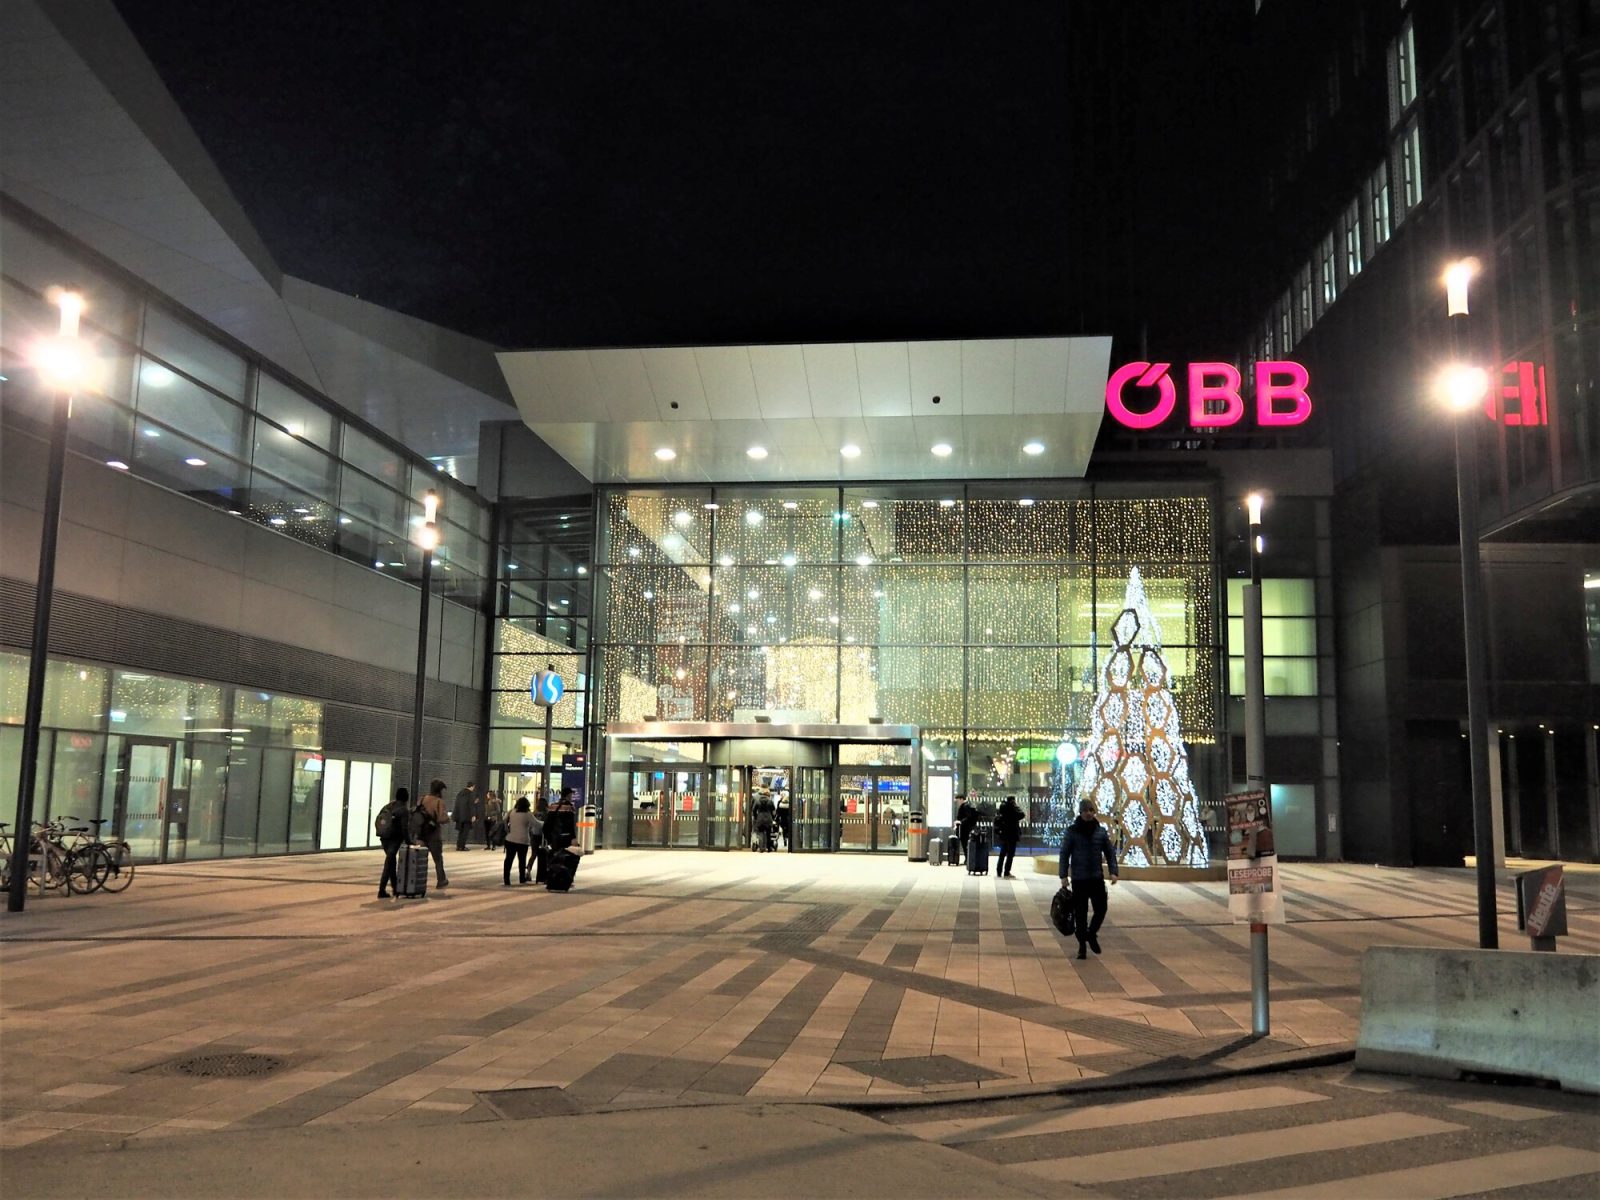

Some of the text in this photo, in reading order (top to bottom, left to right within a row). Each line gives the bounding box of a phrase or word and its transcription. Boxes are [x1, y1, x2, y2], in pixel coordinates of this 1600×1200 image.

[1106, 361, 1312, 429] ÖBB
[1229, 868, 1273, 879] LESEPROBE
[1527, 883, 1557, 930] Heute
